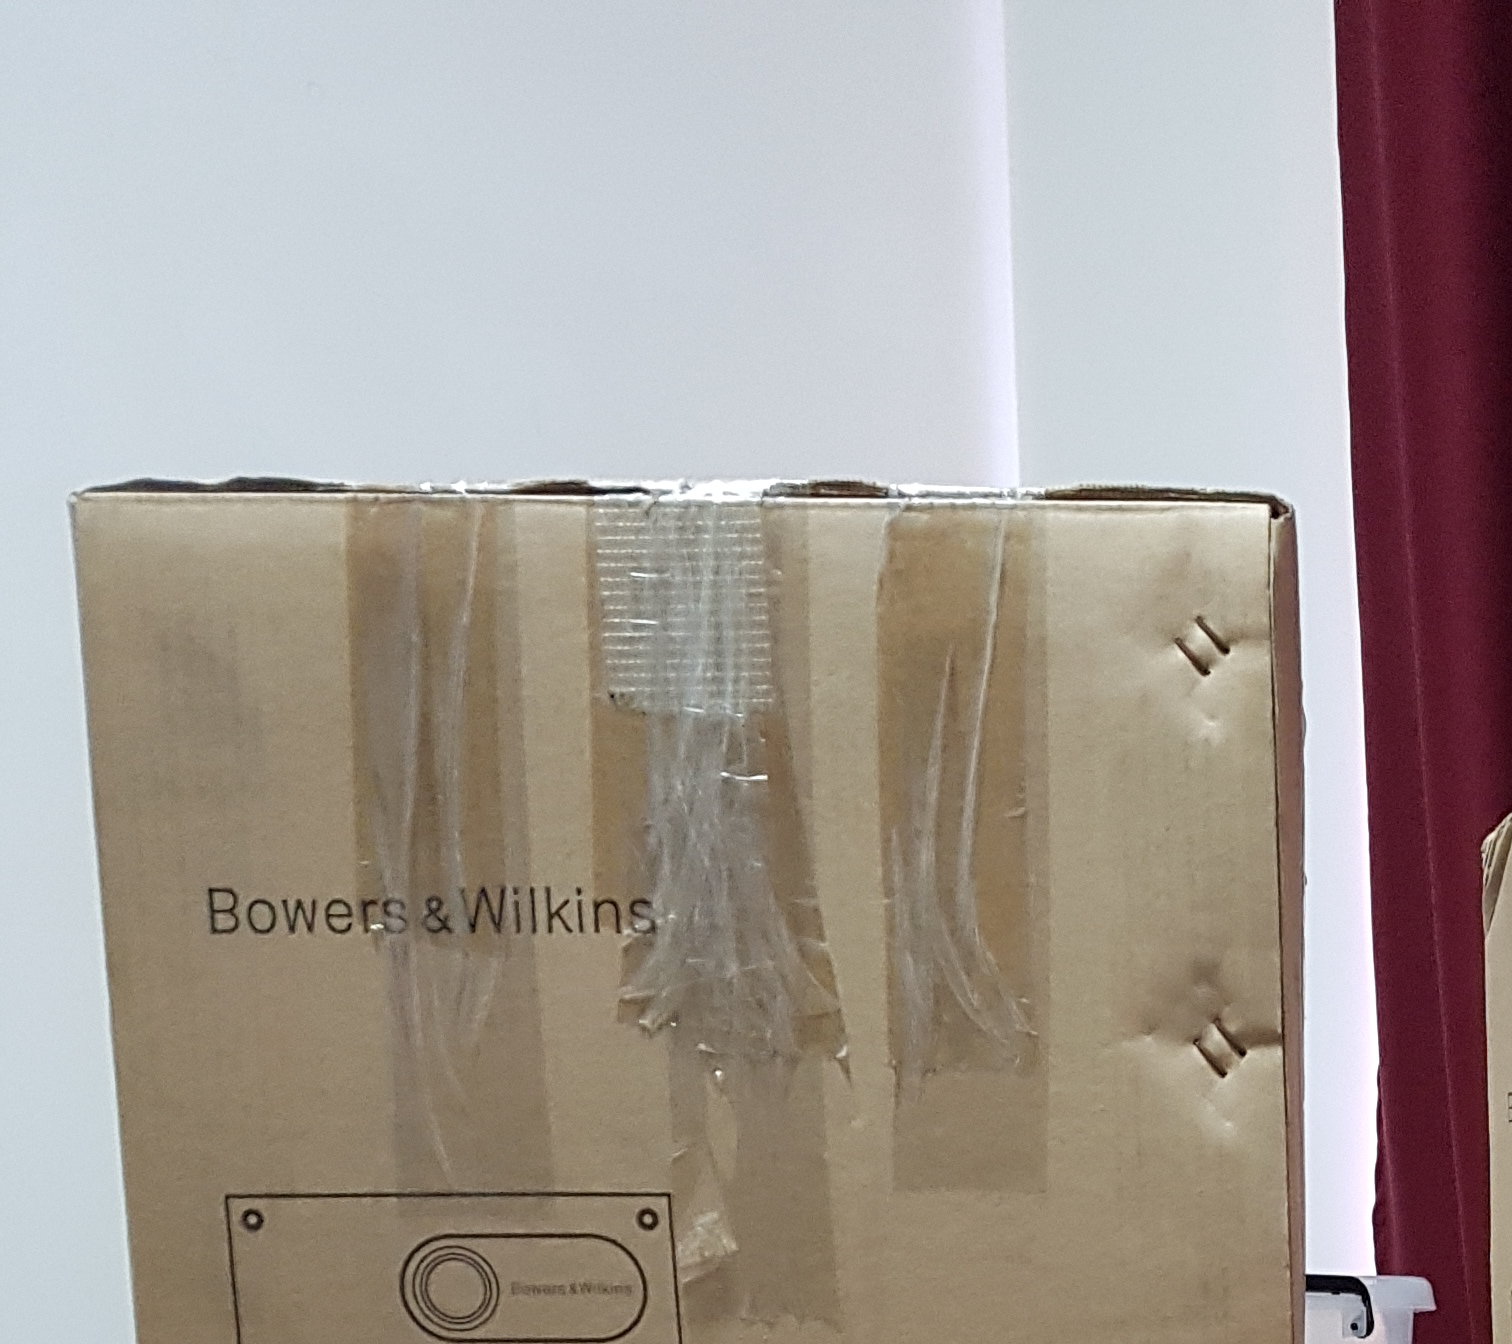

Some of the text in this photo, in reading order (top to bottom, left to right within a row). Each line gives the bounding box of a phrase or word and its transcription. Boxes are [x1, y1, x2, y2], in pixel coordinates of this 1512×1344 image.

[207, 885, 657, 935] Bowers & Wilkins
